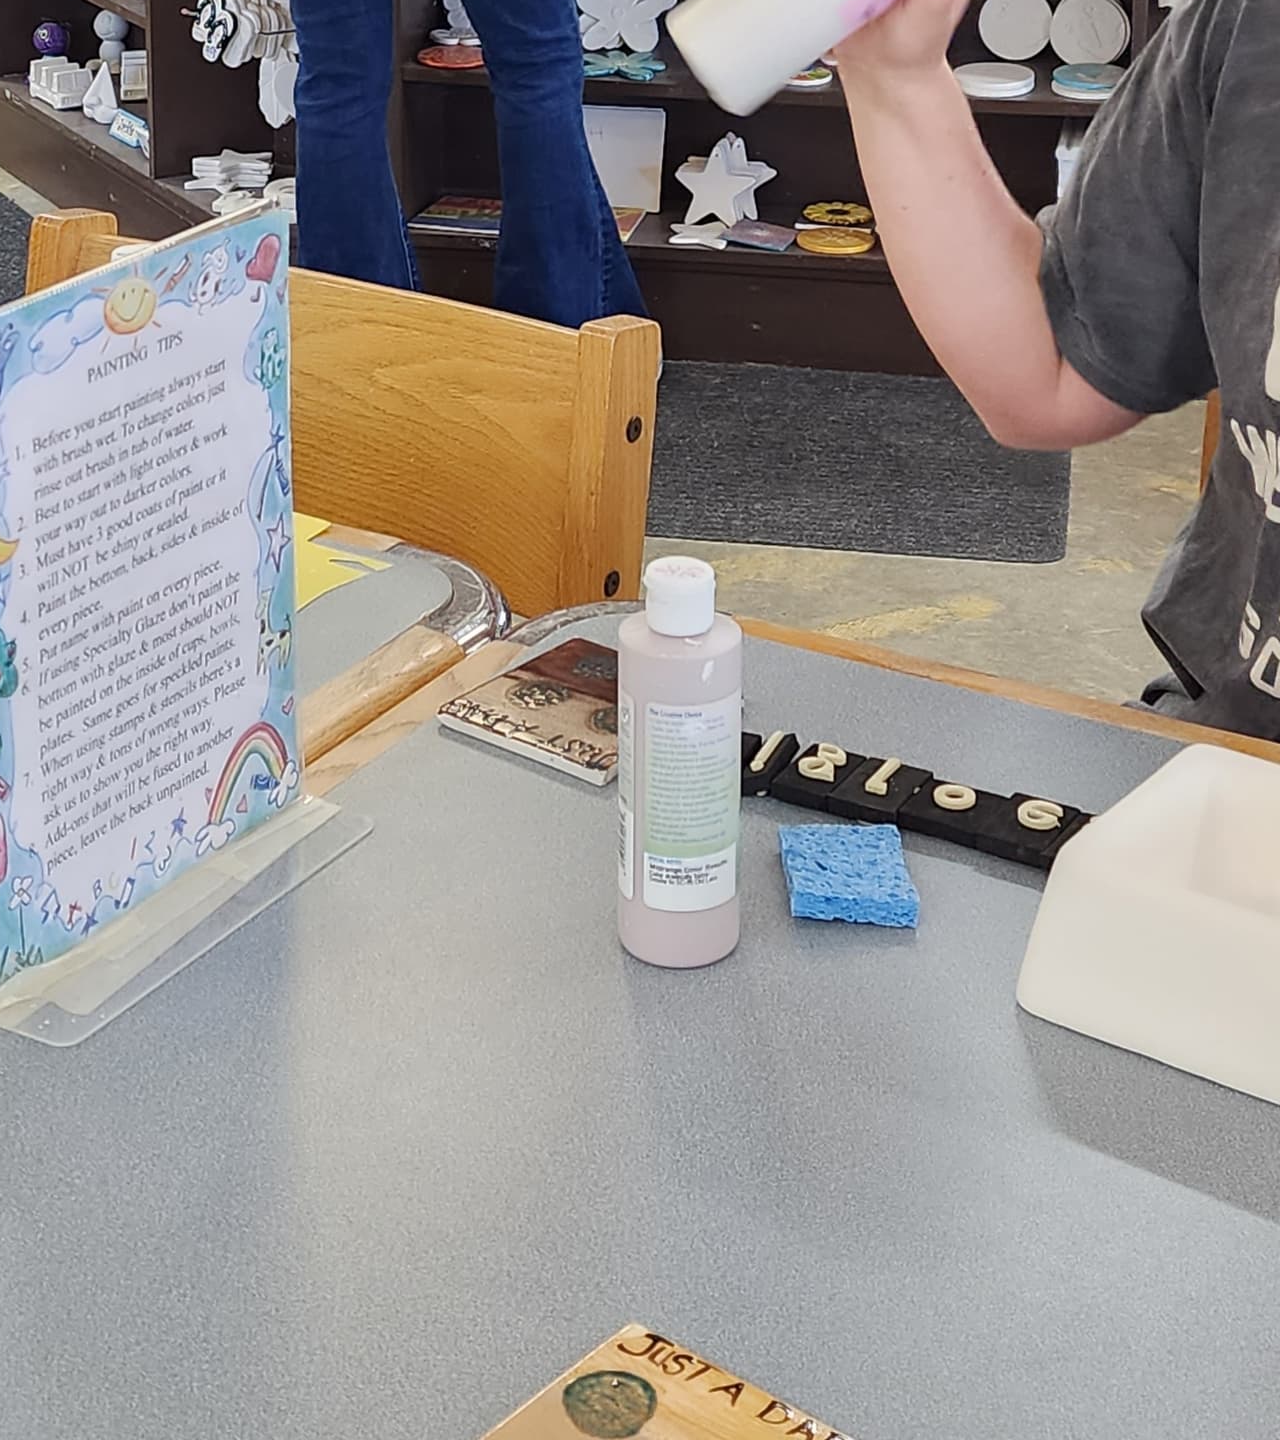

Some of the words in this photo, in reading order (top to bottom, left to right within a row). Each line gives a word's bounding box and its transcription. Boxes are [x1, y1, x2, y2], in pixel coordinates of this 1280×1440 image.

[87, 345, 147, 383] PAINTING
[156, 331, 182, 353] TIPS
[31, 428, 71, 453] Before
[73, 417, 94, 439] you
[97, 404, 120, 425] start
[123, 386, 165, 418] painting
[168, 370, 201, 394] always
[204, 359, 225, 377] start
[33, 454, 58, 475] with
[61, 439, 92, 464] brush
[121, 421, 134, 437] To
[137, 405, 173, 430] change
[175, 391, 205, 413] colors
[208, 380, 225, 402] just
[33, 479, 61, 500] rinse
[64, 468, 82, 486] out
[85, 452, 115, 476] brush
[118, 447, 128, 461] in
[131, 436, 148, 456] tub
[150, 428, 163, 446] of
[34, 502, 59, 524] Best
[63, 497, 74, 511] to
[77, 483, 100, 504] start
[103, 469, 126, 490] with
[129, 458, 153, 480] light
[155, 444, 187, 466] colors
[190, 435, 199, 451] &
[202, 422, 227, 444] work
[34, 525, 61, 552] your
[64, 515, 86, 532] way
[89, 502, 106, 520] out
[109, 498, 120, 512] to
[123, 479, 156, 504] darker
[36, 546, 64, 571] Must
[67, 534, 93, 555] have
[97, 525, 102, 541] 3
[106, 510, 133, 540] good
[135, 501, 162, 522] coats
[165, 489, 176, 508] of
[178, 479, 203, 506] paint
[205, 474, 216, 488] or
[218, 468, 225, 481] it
[37, 593, 65, 618] Paint
[69, 584, 86, 601] the
[160, 532, 185, 553] sides
[188, 523, 197, 539] &
[201, 508, 230, 533] inside
[232, 499, 243, 517] of
[37, 570, 58, 592] will
[61, 554, 88, 581] NOT
[95, 550, 108, 564] be
[111, 534, 139, 557] shiny
[142, 527, 153, 541] or
[38, 617, 68, 640] every
[617, 1333, 724, 1381] JUST
[708, 1382, 746, 1407] A
[756, 1399, 848, 1440] DA
